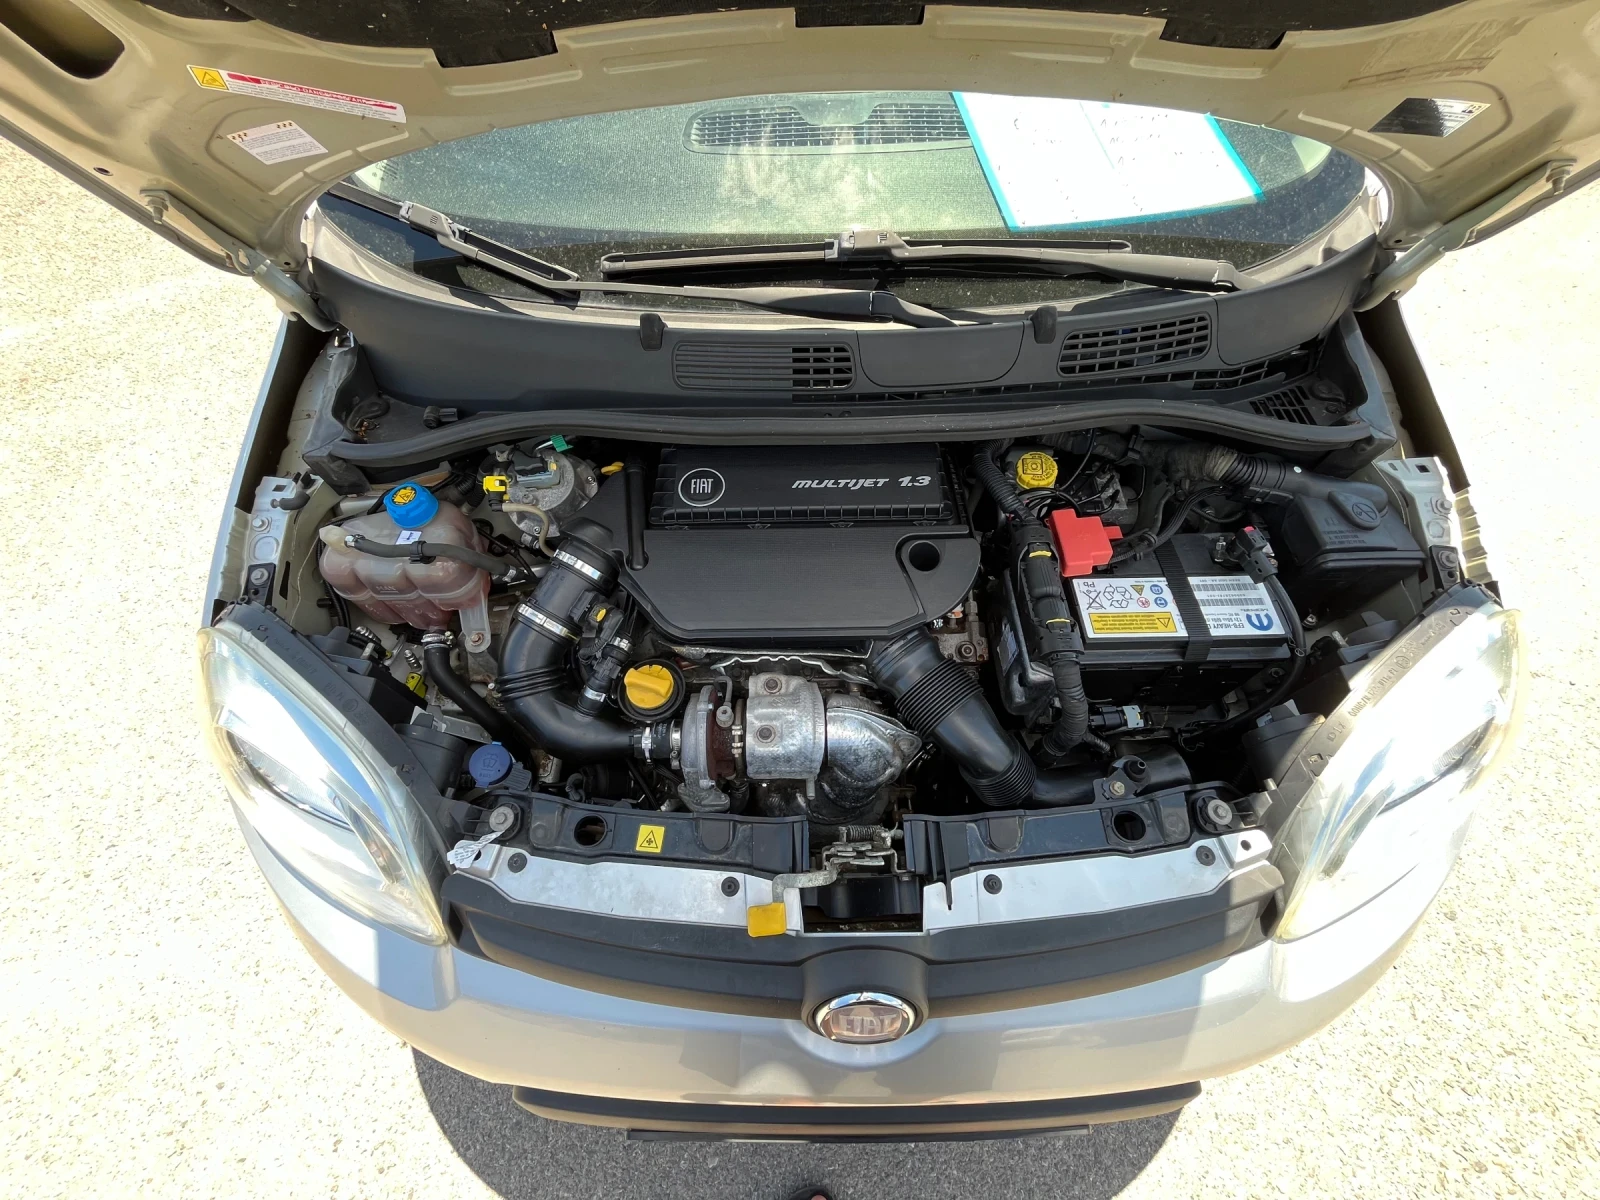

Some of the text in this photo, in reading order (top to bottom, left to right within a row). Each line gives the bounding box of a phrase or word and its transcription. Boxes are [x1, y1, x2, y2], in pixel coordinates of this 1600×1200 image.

[690, 477, 714, 494] FIAT
[791, 475, 932, 490] MULTIJET 1.3
[838, 1013, 897, 1036] FIAT
